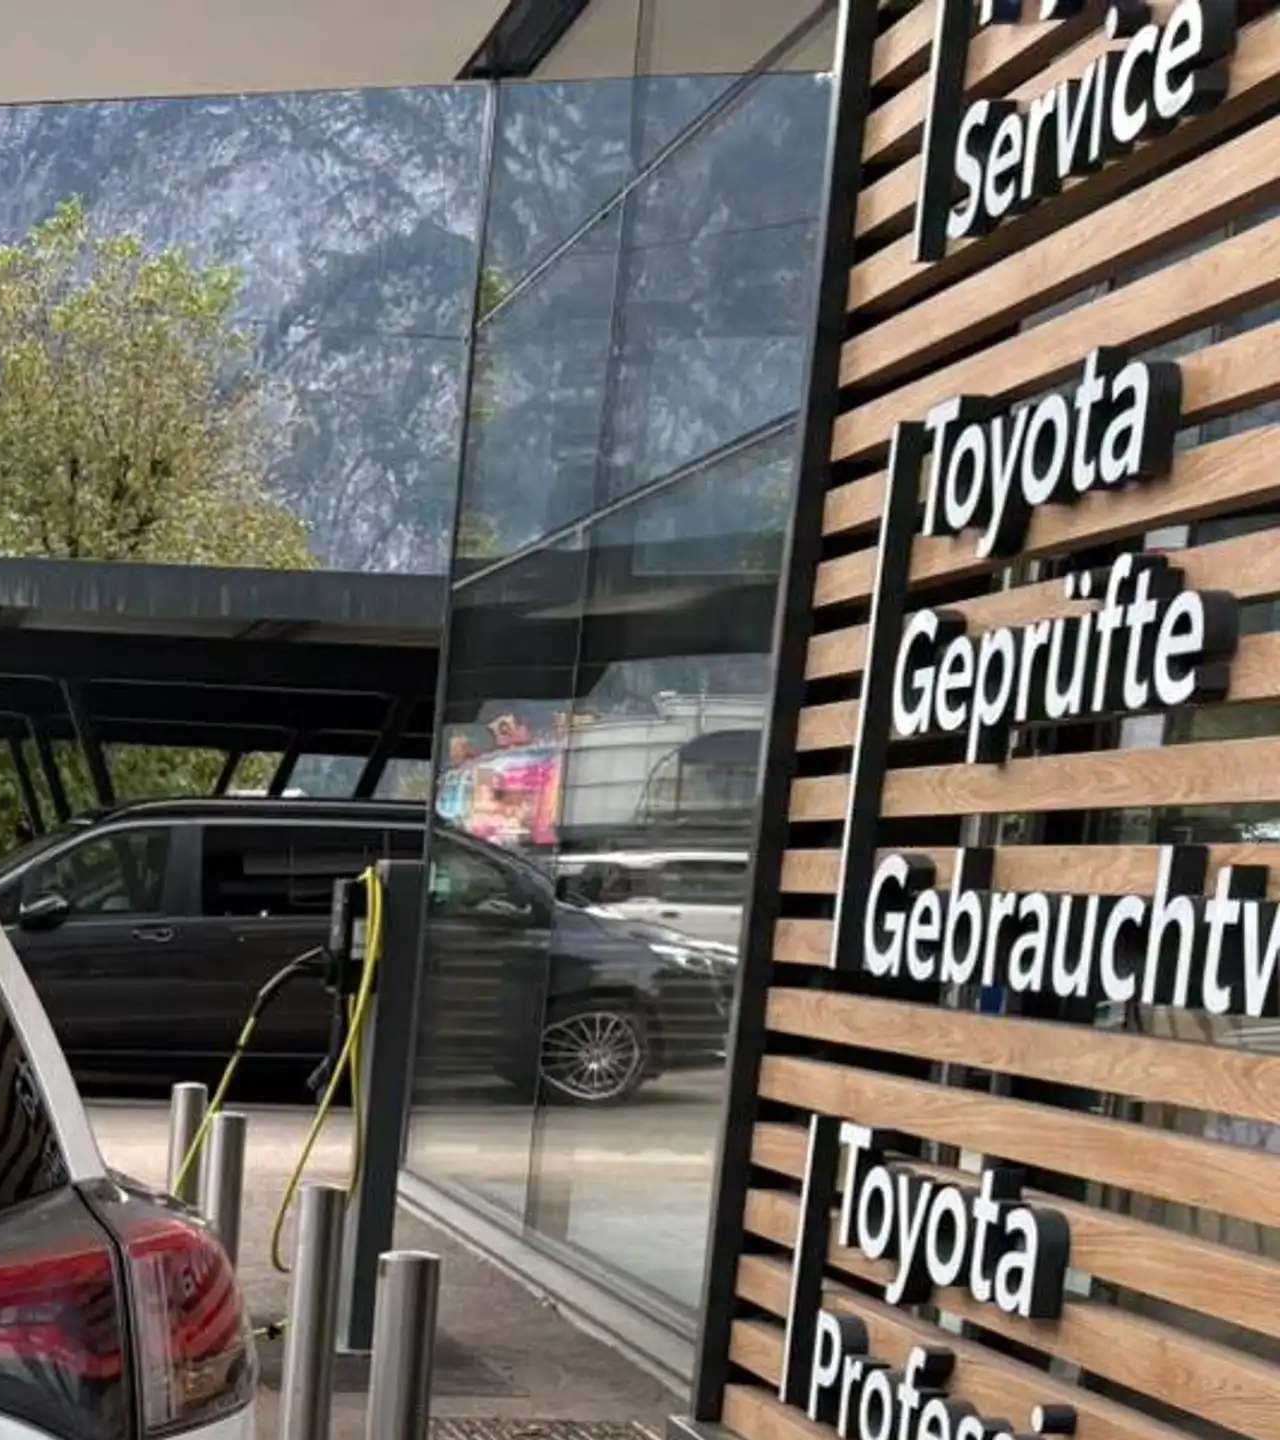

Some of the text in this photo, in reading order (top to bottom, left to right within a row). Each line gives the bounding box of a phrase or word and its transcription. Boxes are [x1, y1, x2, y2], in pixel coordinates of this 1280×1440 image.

[946, 0, 1203, 239] Service
[923, 346, 1150, 559] Toyota
[892, 553, 1205, 764] Geprüfte
[840, 1123, 1039, 1318] Toyota
